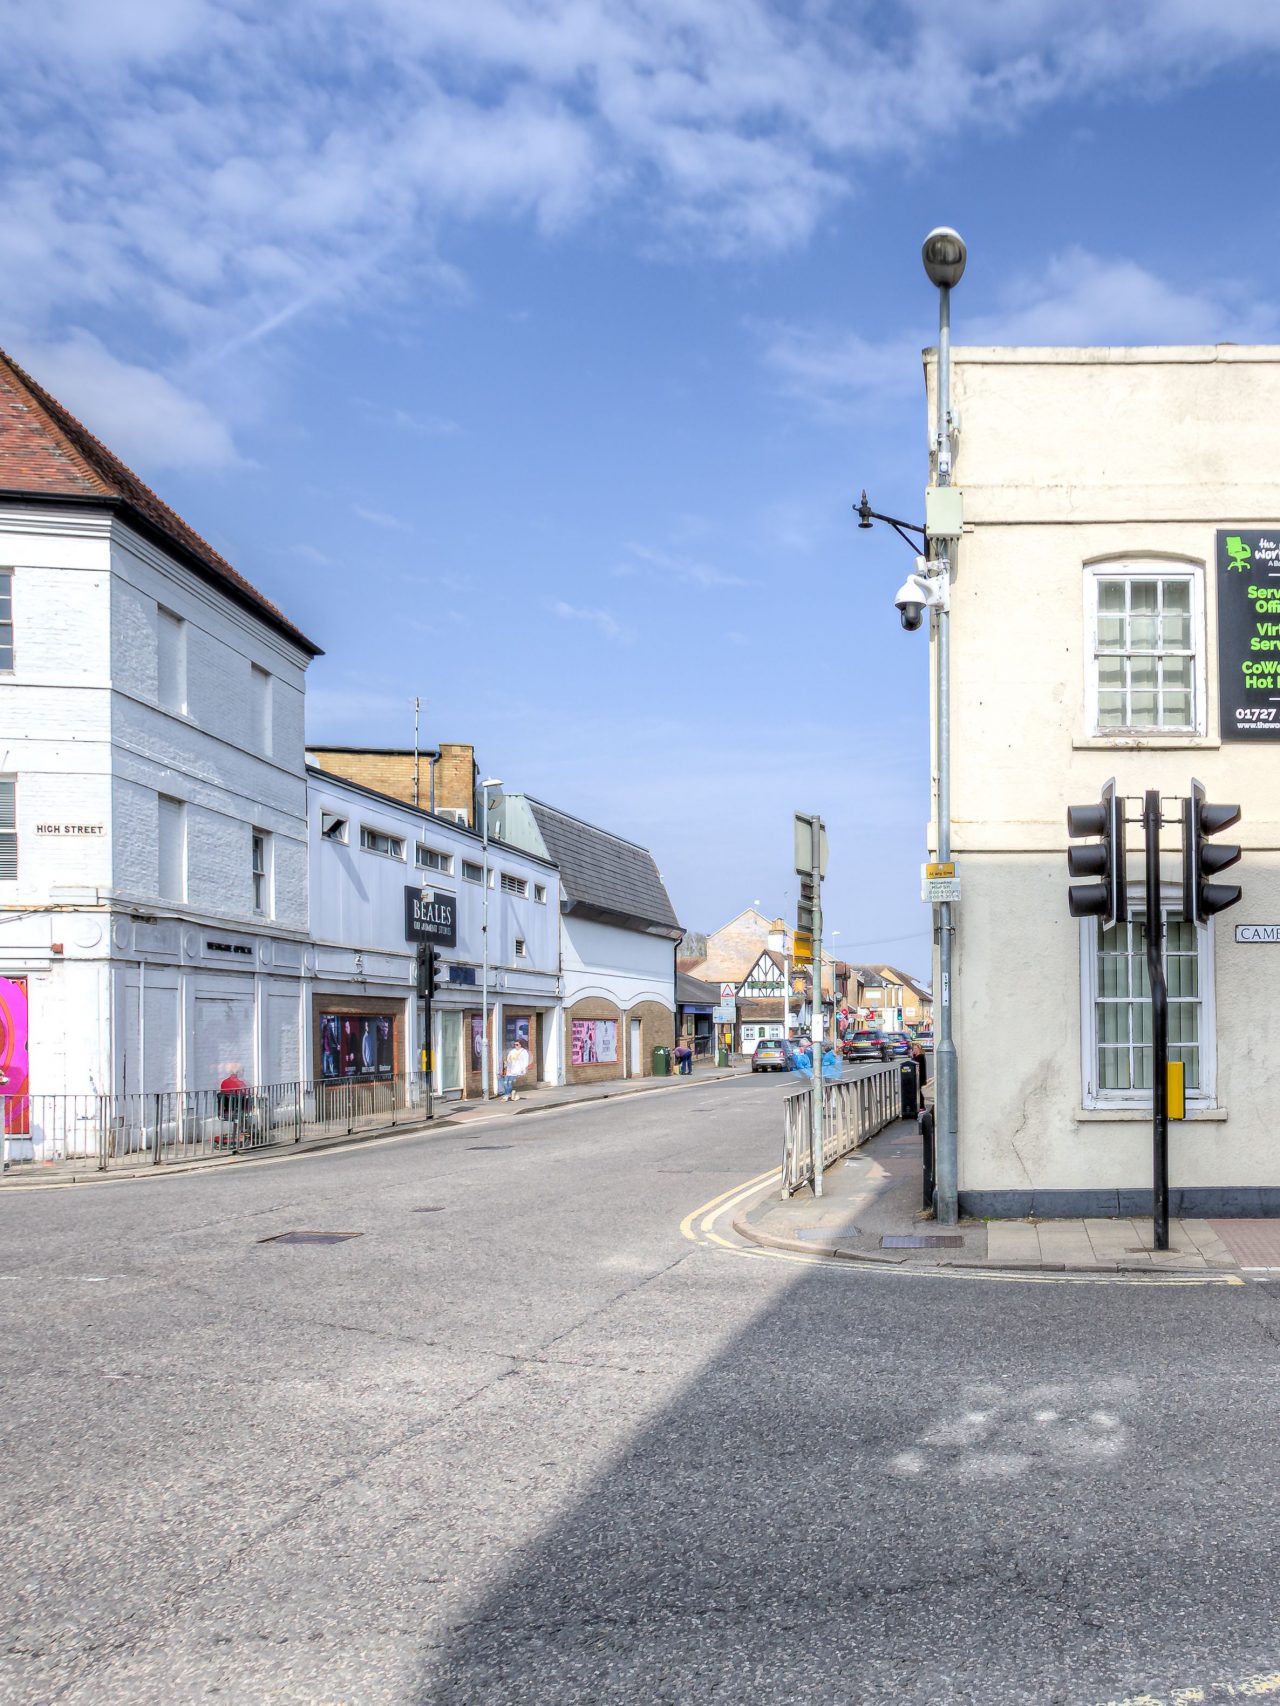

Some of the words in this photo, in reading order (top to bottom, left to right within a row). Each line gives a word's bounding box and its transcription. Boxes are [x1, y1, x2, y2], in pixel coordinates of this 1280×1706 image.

[1259, 537, 1276, 549] the
[1245, 675, 1274, 689] Hot
[1235, 708, 1277, 721] 01727
[36, 825, 61, 833] HIGH
[64, 825, 104, 834] STREET
[413, 899, 451, 925] BEALES
